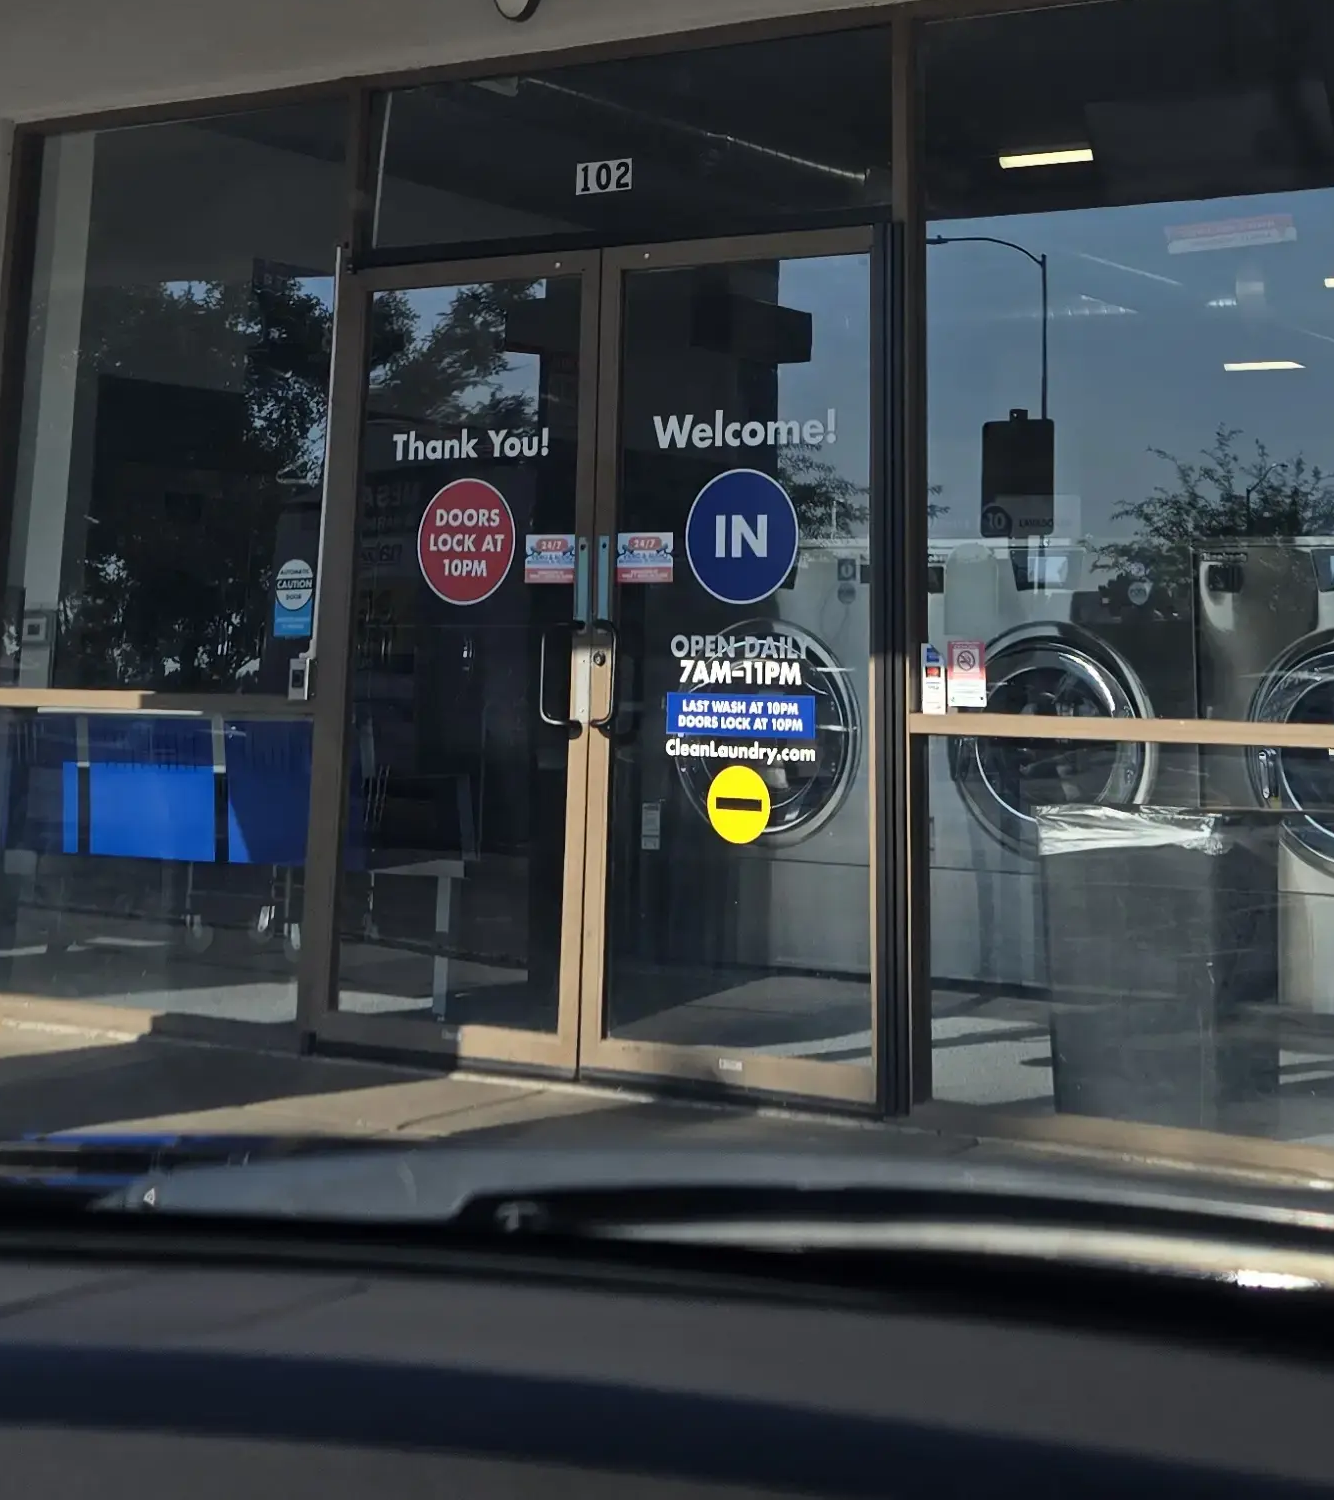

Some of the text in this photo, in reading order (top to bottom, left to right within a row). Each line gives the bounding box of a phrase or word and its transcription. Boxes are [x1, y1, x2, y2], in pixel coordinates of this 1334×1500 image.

[581, 161, 630, 192] 102
[653, 408, 837, 449] Welcome!
[393, 427, 550, 462] Thank You!
[435, 509, 500, 527] DOORS
[429, 534, 505, 553] LOCK AT
[633, 539, 656, 549] 24/7
[715, 514, 767, 558] IN
[541, 541, 562, 550] 24/7
[443, 559, 487, 577] 10PM
[277, 579, 313, 589] CAUTION
[670, 634, 810, 660] OPEN DAILY
[682, 699, 799, 716] LAST WASH AT 10PM
[678, 715, 804, 732] DOORS LOCK AT 10PM
[665, 737, 816, 765] CleanLaundry.com
